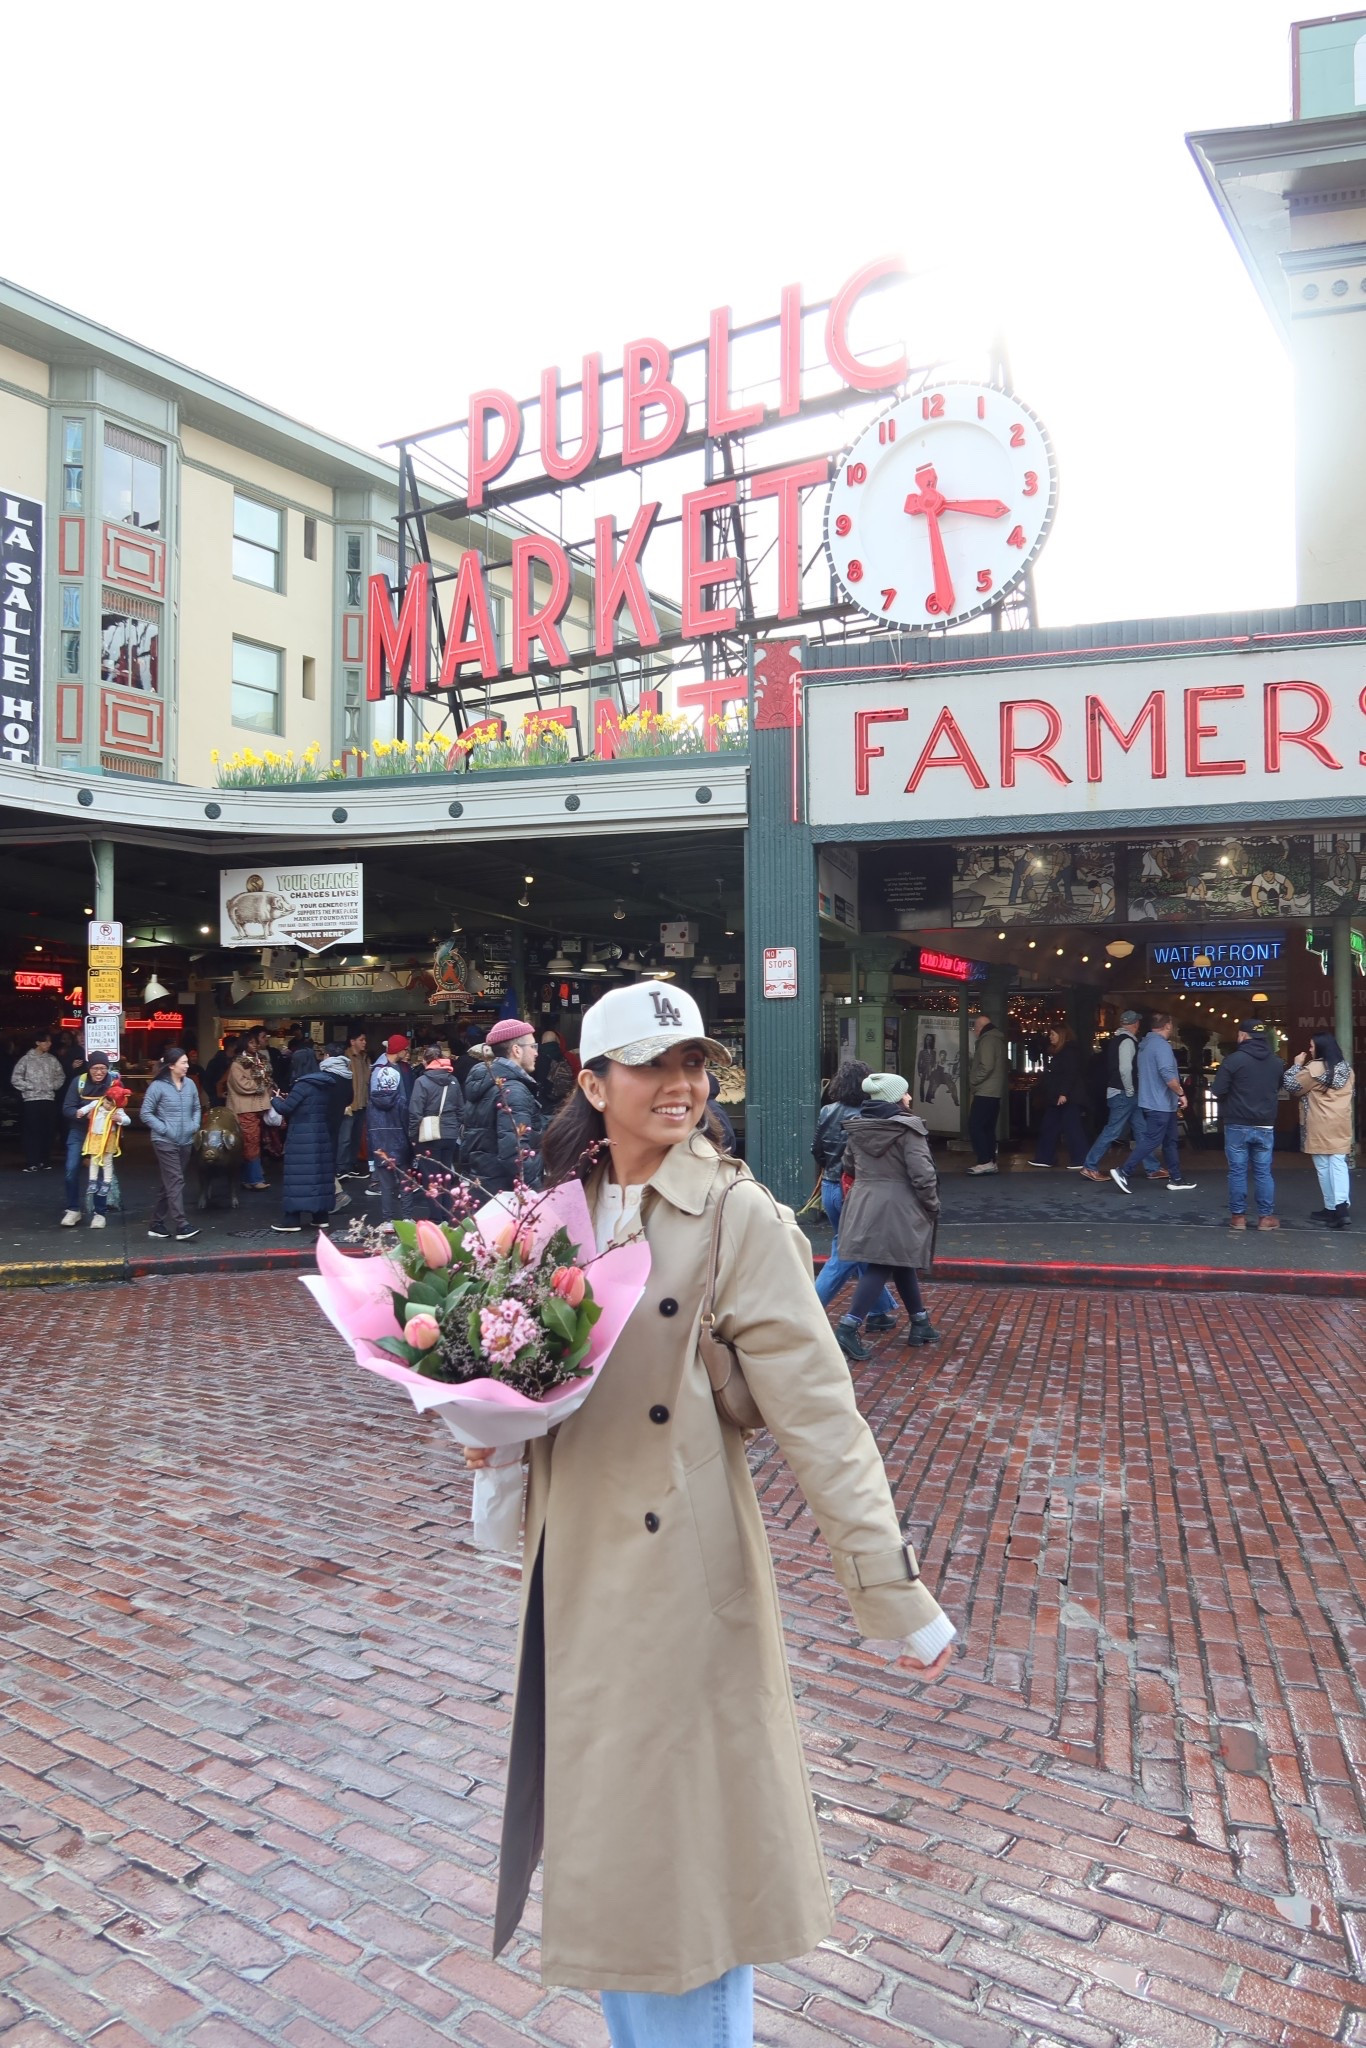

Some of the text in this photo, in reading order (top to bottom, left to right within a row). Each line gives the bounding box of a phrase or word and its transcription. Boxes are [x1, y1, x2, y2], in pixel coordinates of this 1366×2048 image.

[466, 254, 908, 508] PUBLIC
[922, 393, 945, 420] 12
[977, 395, 985, 420] 1
[879, 419, 896, 445] 11
[1009, 423, 1026, 448] 2
[846, 462, 867, 487] 10
[1022, 470, 1039, 496] 3
[5, 498, 35, 552] LA
[835, 514, 852, 537] 9
[1006, 525, 1026, 550] 4
[366, 457, 833, 700] MARKET
[846, 559, 864, 583] 8
[976, 568, 993, 593] 5
[880, 588, 897, 611] 7
[925, 592, 943, 615] 6
[3, 561, 33, 685] SALLE
[855, 681, 1366, 796] FARMER
[276, 872, 359, 892] YOUR CHANGE
[290, 891, 330, 899] CHANGES
[768, 960, 793, 969] STOPS
[1154, 943, 1281, 964] WATERFRONT
[1171, 964, 1264, 980] VIEWPOINT
[649, 991, 682, 1026] LA
